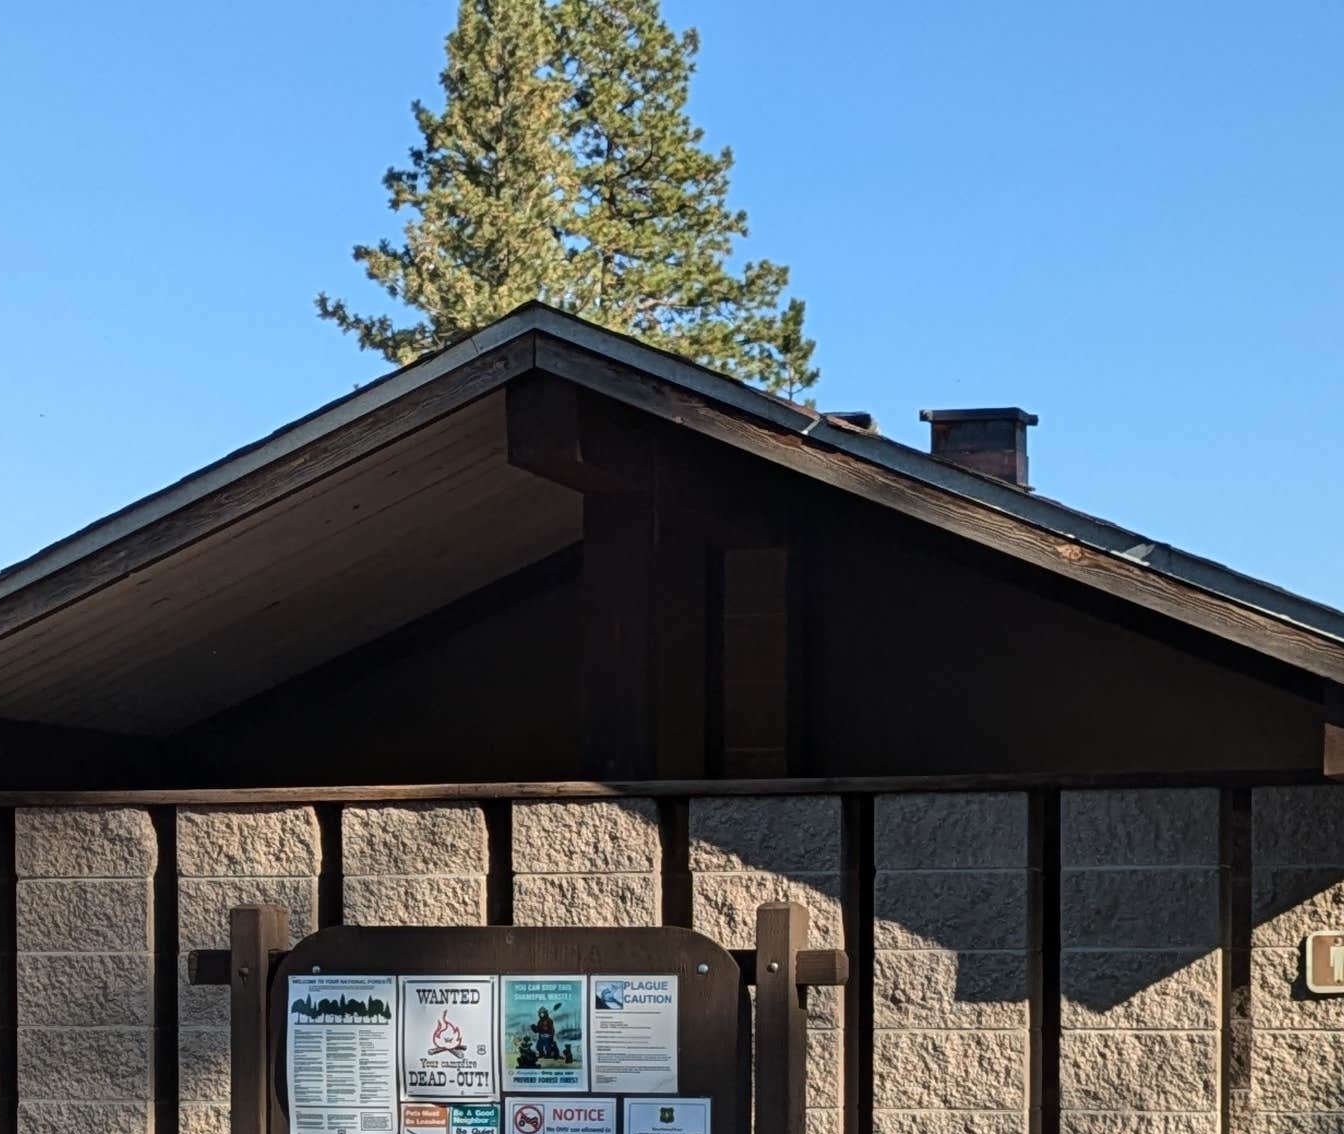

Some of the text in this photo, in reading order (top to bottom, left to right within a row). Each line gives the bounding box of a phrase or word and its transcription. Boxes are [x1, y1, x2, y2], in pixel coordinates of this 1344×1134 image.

[623, 981, 668, 990] PLAGUE
[416, 988, 480, 1004] WANTED
[623, 994, 672, 1004] CAUTION
[420, 1058, 478, 1071] Your campfire
[552, 1108, 605, 1121] NOTICE
